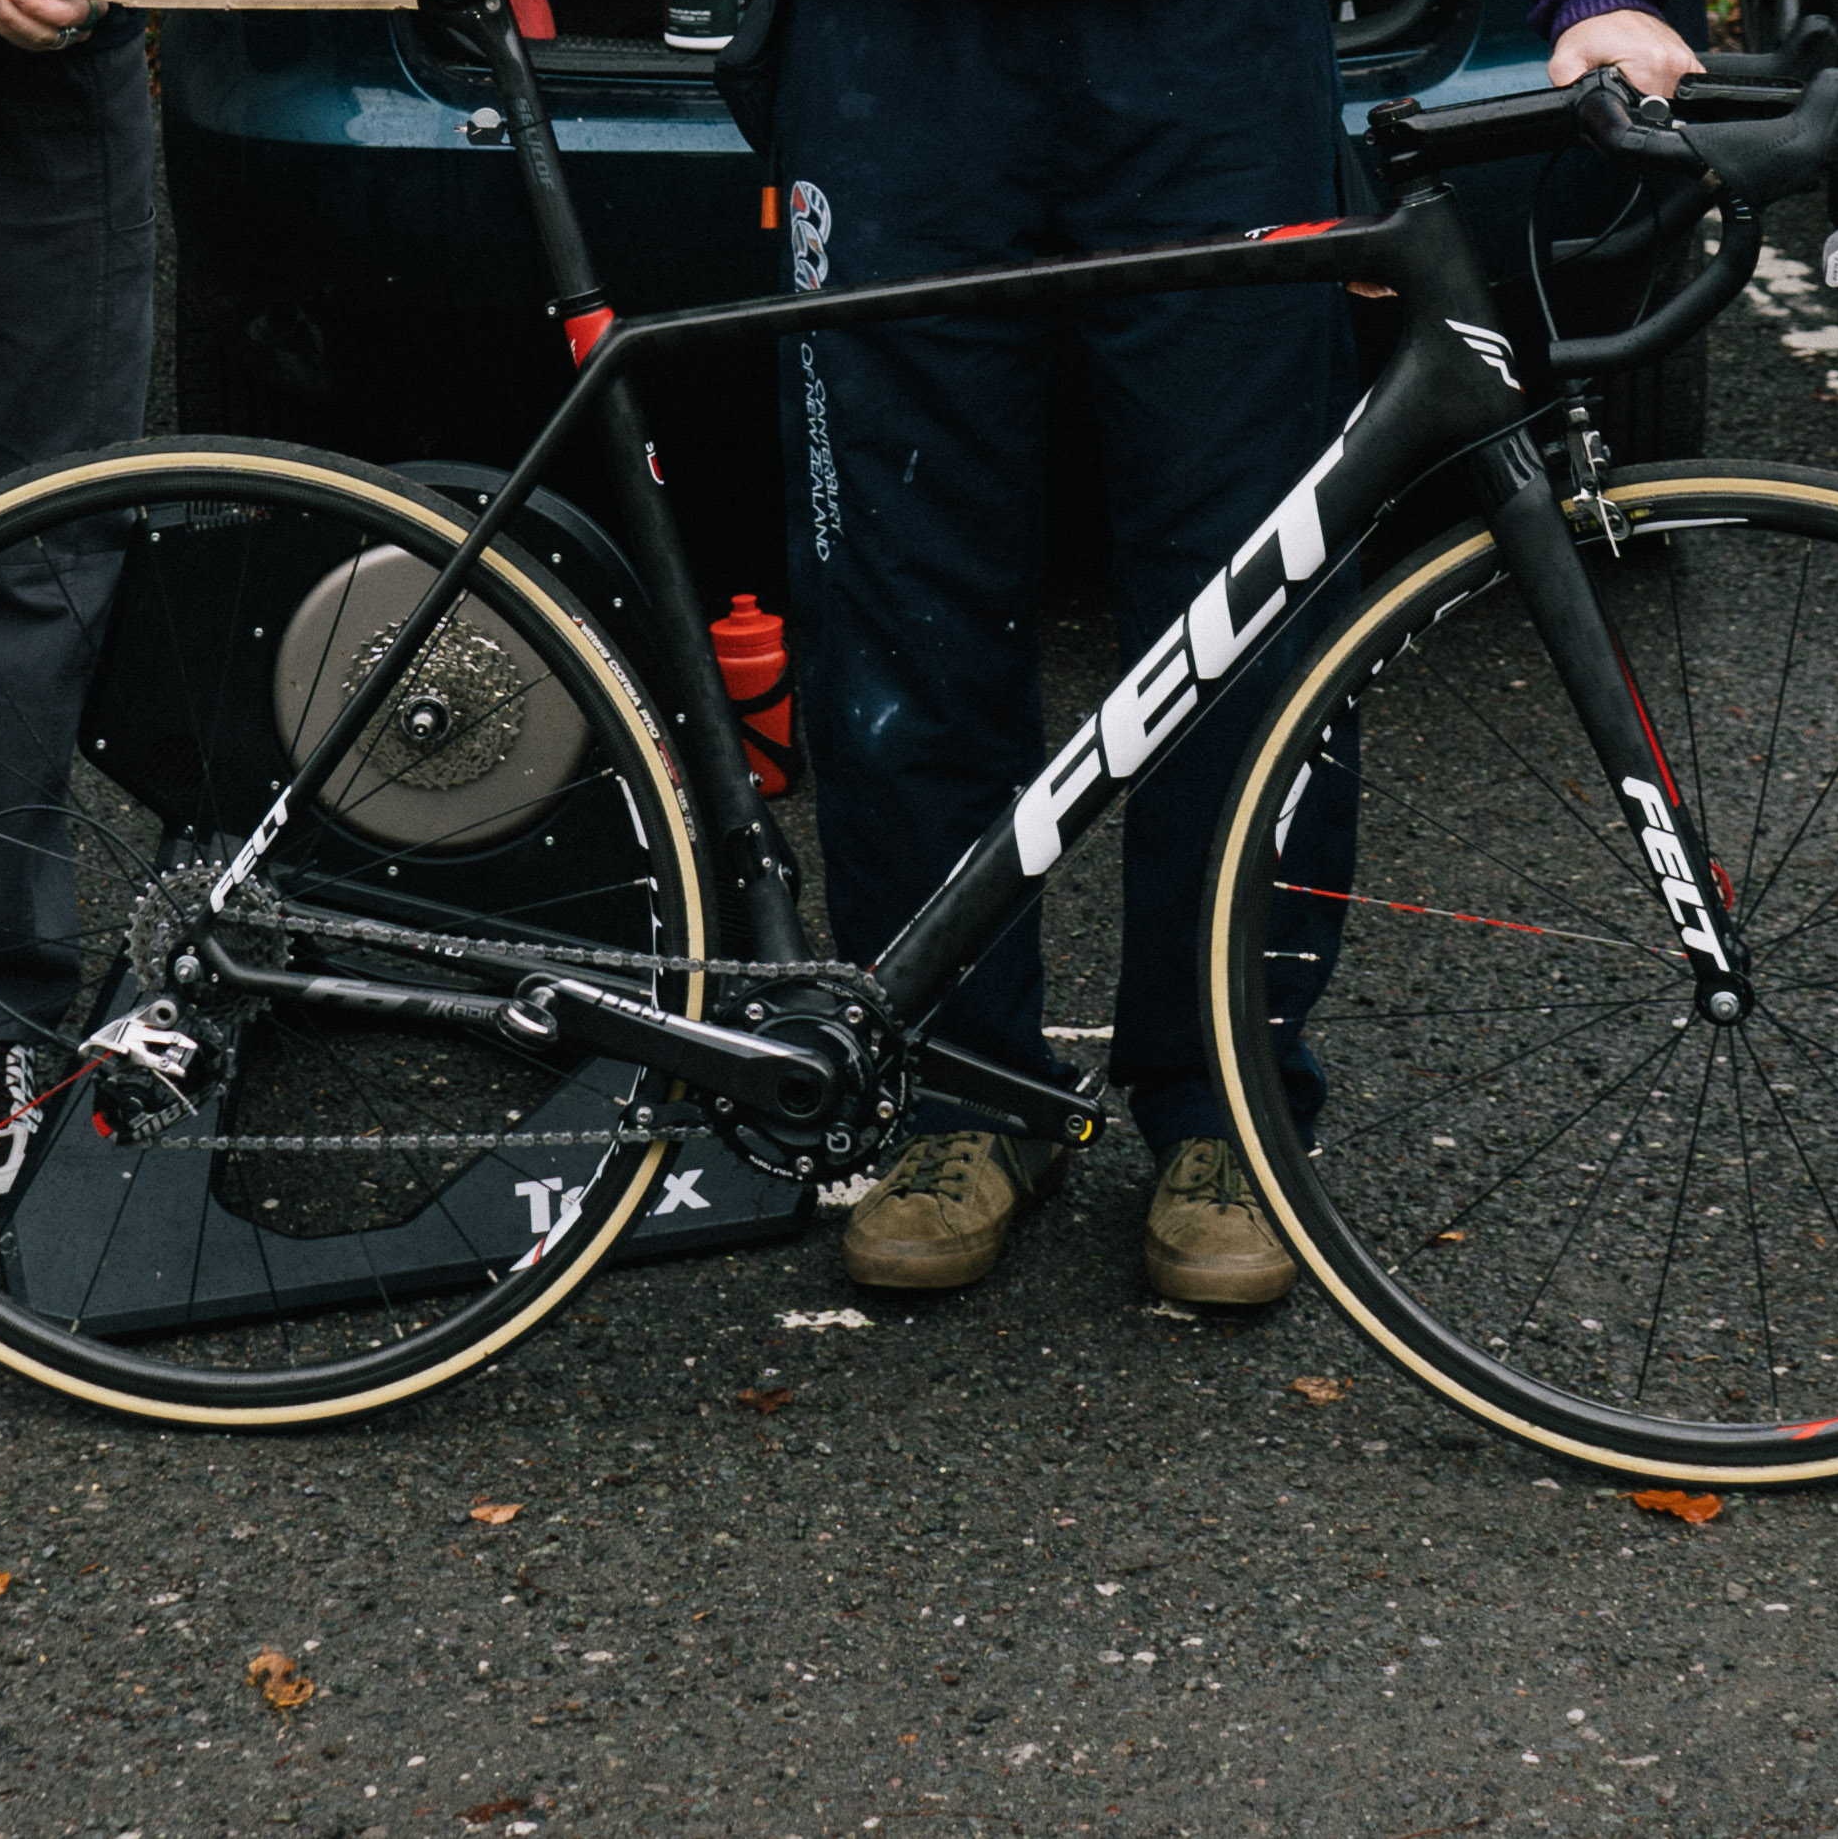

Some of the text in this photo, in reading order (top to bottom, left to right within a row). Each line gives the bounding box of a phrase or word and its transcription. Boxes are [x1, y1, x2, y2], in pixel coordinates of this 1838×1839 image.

[800, 342, 829, 562] OF NEW ZEALAND
[815, 378, 844, 536] CANTERBURY
[1013, 386, 1375, 877] FELT
[210, 784, 292, 913] FELT
[1621, 775, 1730, 973] FELT
[514, 1168, 711, 1234] Tax
